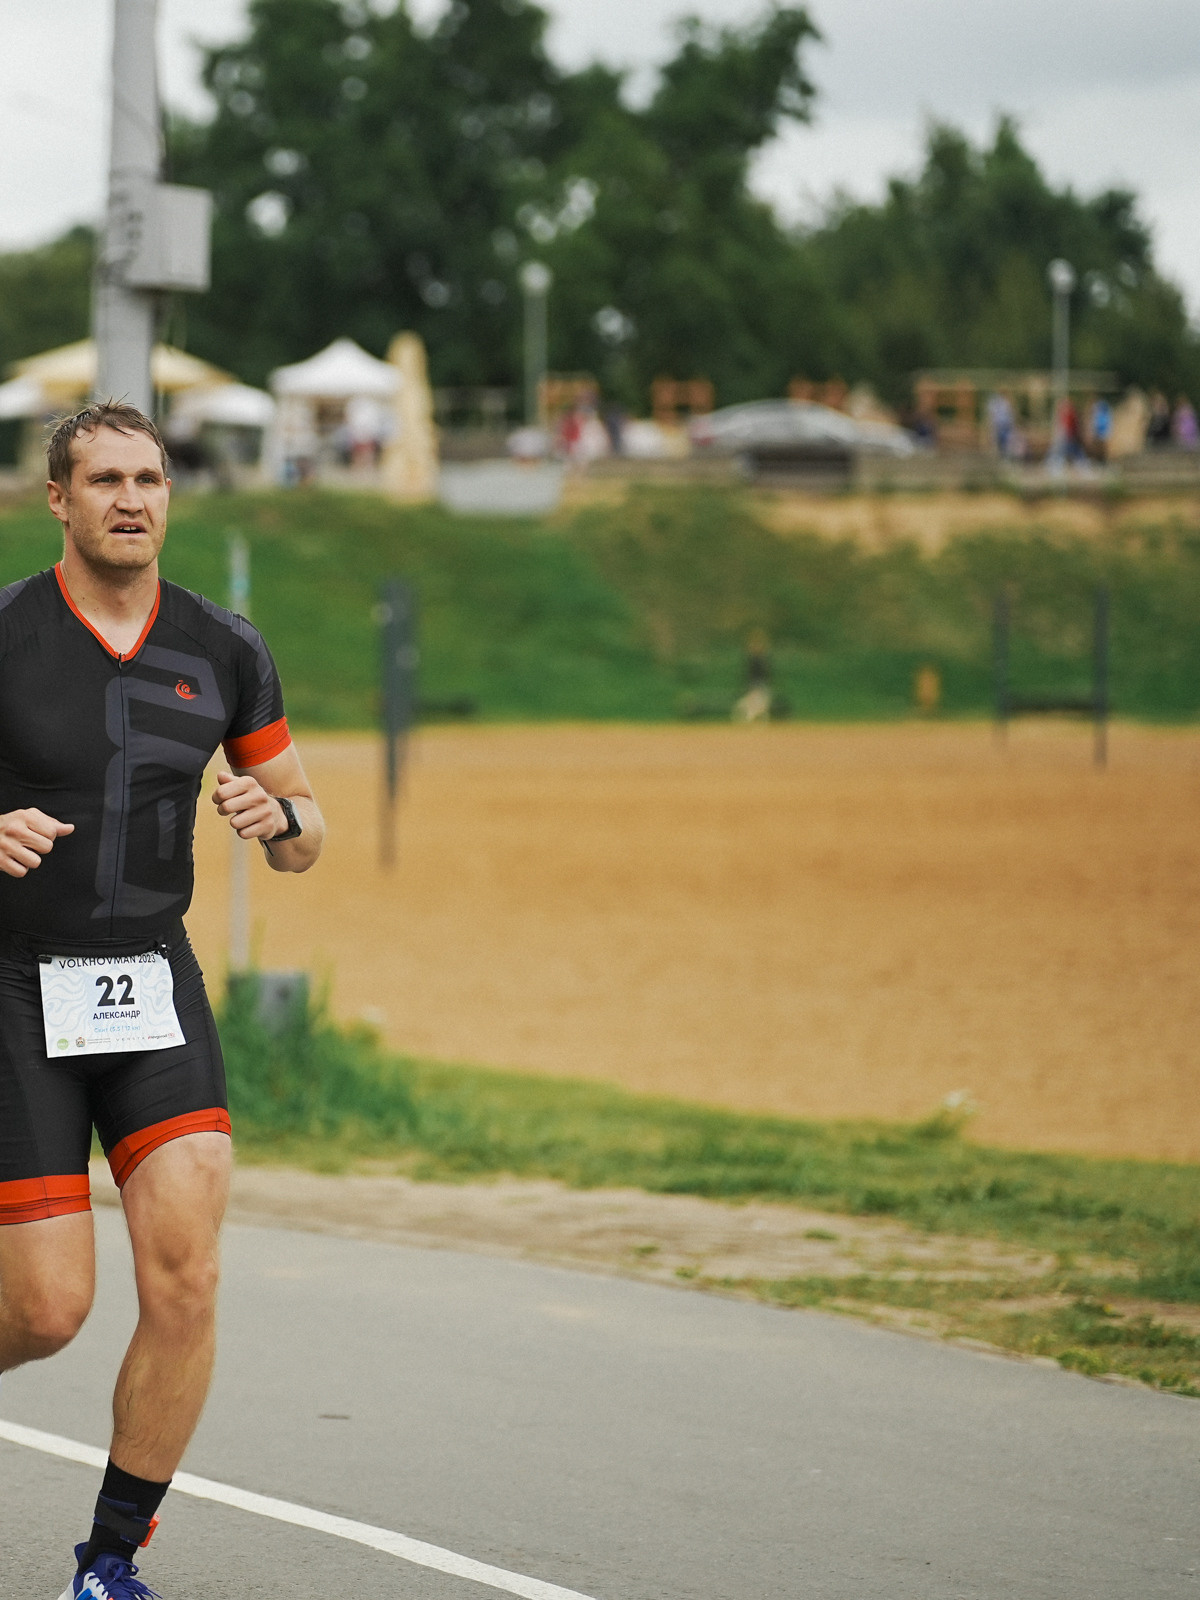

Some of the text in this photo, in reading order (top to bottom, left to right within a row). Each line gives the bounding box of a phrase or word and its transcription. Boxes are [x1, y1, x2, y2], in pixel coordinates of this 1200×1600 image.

[59, 954, 156, 969] VOLKHOVMAN 2023
[95, 974, 135, 1007] 22
[93, 1010, 141, 1020] АЛЕКСАНДР
